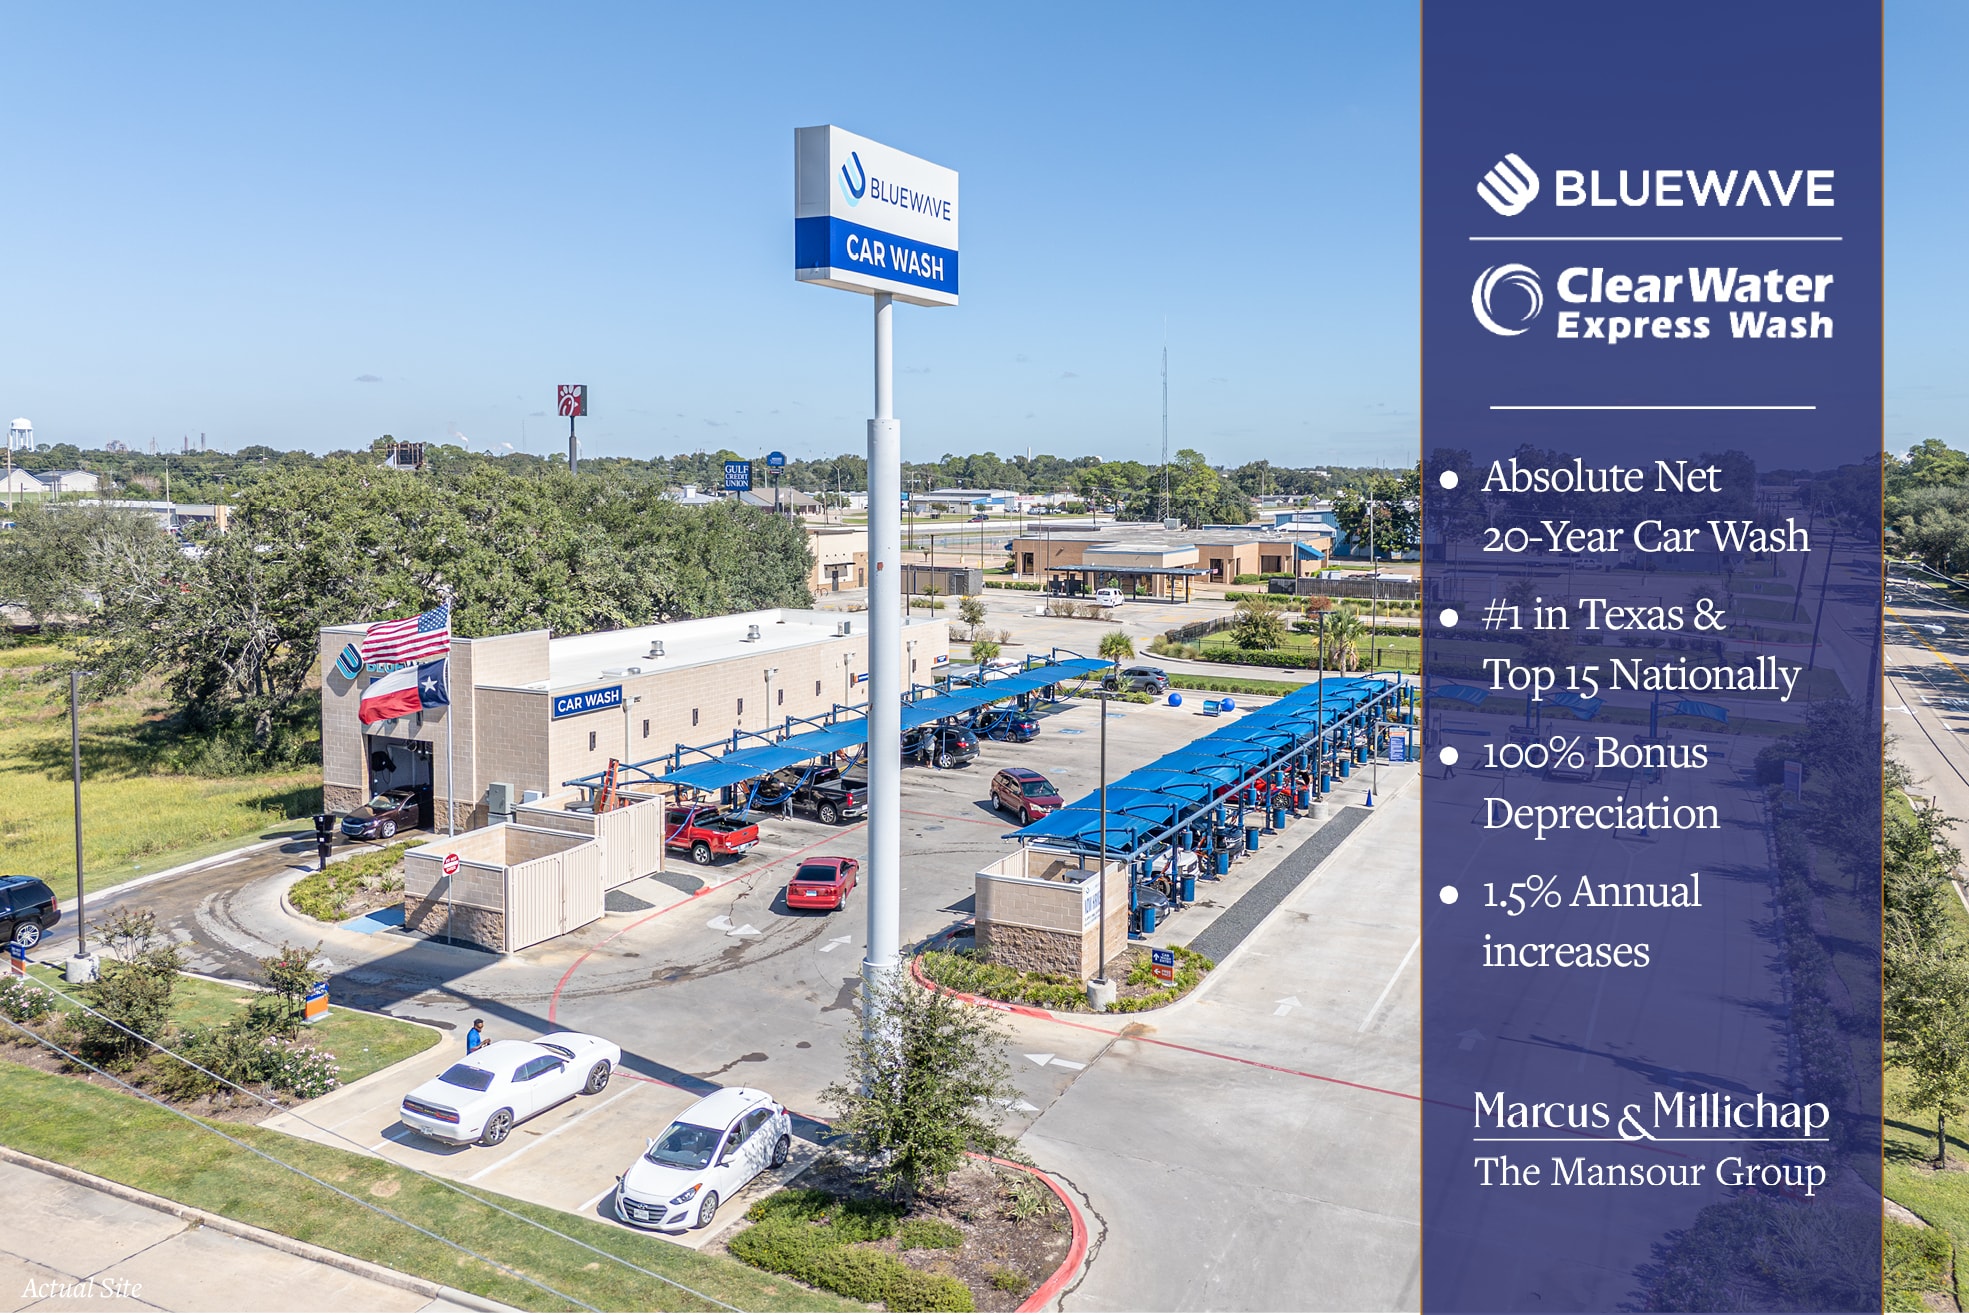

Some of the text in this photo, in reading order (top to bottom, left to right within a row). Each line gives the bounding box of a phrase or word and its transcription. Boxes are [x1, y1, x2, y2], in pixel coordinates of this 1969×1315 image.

[871, 177, 951, 221] BLUEWAVE
[846, 234, 944, 281] CAR WASH
[725, 465, 749, 474] GULF
[558, 690, 619, 712] CAR WASH
